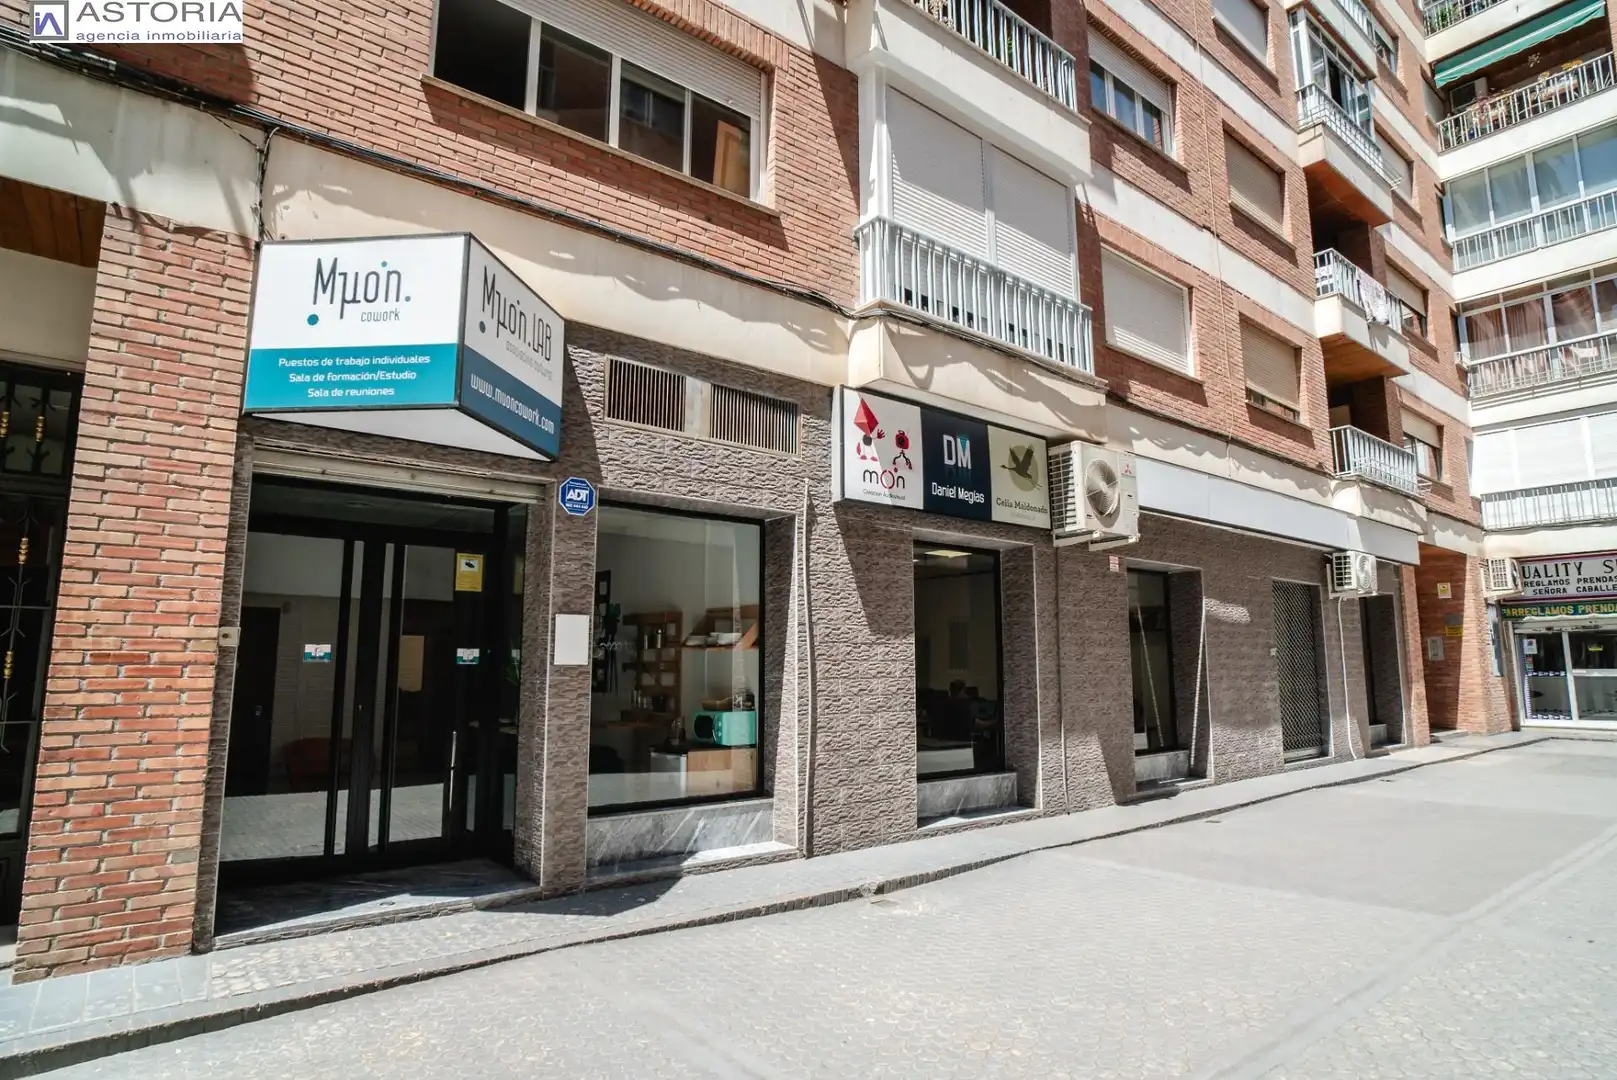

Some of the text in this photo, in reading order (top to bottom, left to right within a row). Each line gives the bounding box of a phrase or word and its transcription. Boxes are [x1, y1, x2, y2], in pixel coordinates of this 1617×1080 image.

[360, 308, 400, 322] cowork
[278, 354, 431, 367] Puestos de trabajo individuales
[289, 371, 416, 382] Sala de formación/Estudio
[308, 387, 395, 397] Sala de reuniones
[470, 373, 555, 435] www.muoncowork.com
[943, 434, 972, 469] DM
[567, 489, 589, 501] ADT
[931, 482, 956, 498] Daniel
[1603, 559, 1617, 574] S
[1533, 587, 1568, 596] SEÑORA
[1506, 605, 1574, 616] ARREGLAMOS
